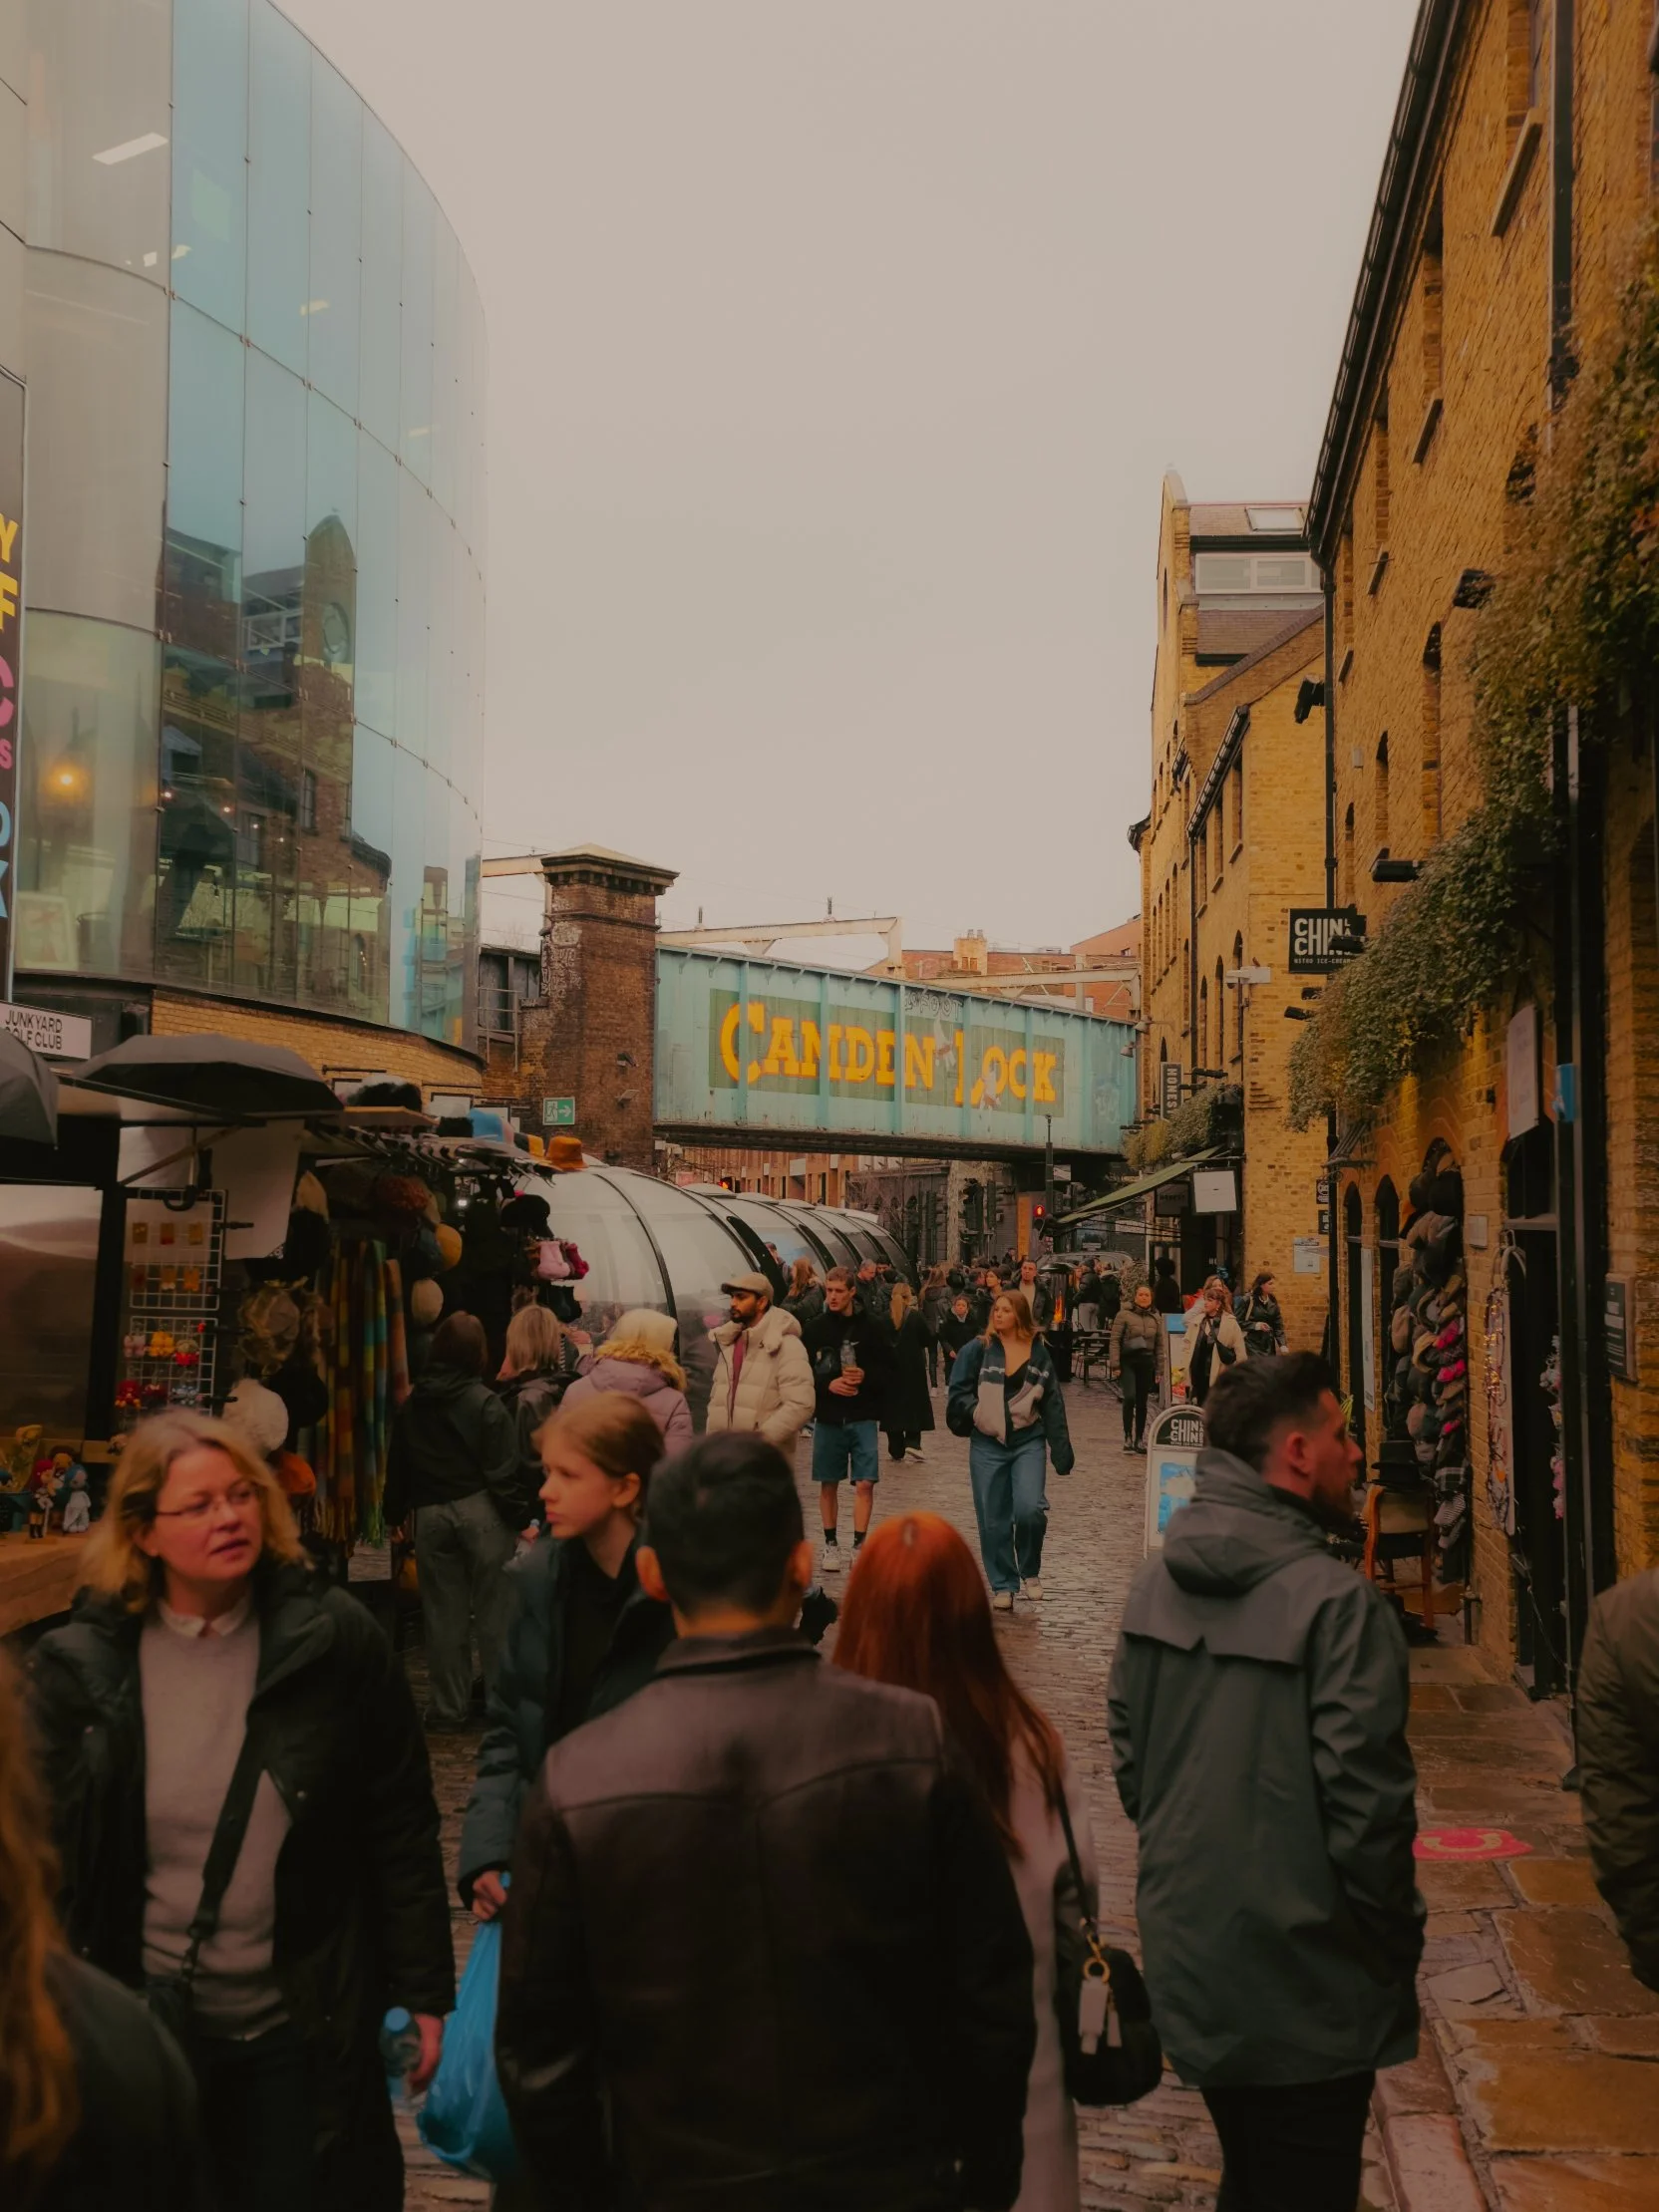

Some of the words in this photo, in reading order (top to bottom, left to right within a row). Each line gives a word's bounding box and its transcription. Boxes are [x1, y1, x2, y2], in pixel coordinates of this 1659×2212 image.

[5, 1010, 63, 1034] JUNKYARD
[35, 1031, 63, 1050] CLUB
[720, 1001, 936, 1090] CAMDEN
[953, 1029, 1057, 1106] LOCK
